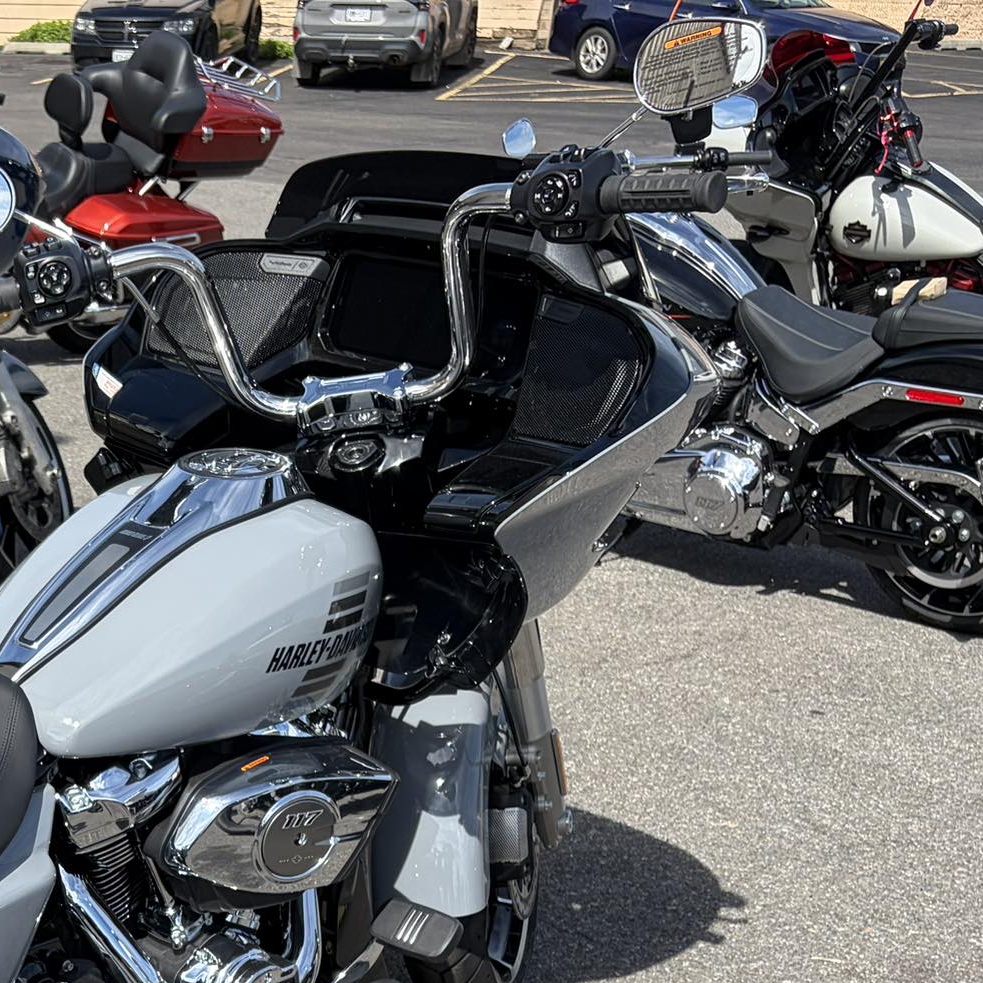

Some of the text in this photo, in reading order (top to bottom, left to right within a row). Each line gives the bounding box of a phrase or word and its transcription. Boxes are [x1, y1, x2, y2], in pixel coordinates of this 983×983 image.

[680, 30, 712, 44] WARNING
[265, 620, 370, 674] HARLEY-DAVID
[282, 809, 324, 830] 117
